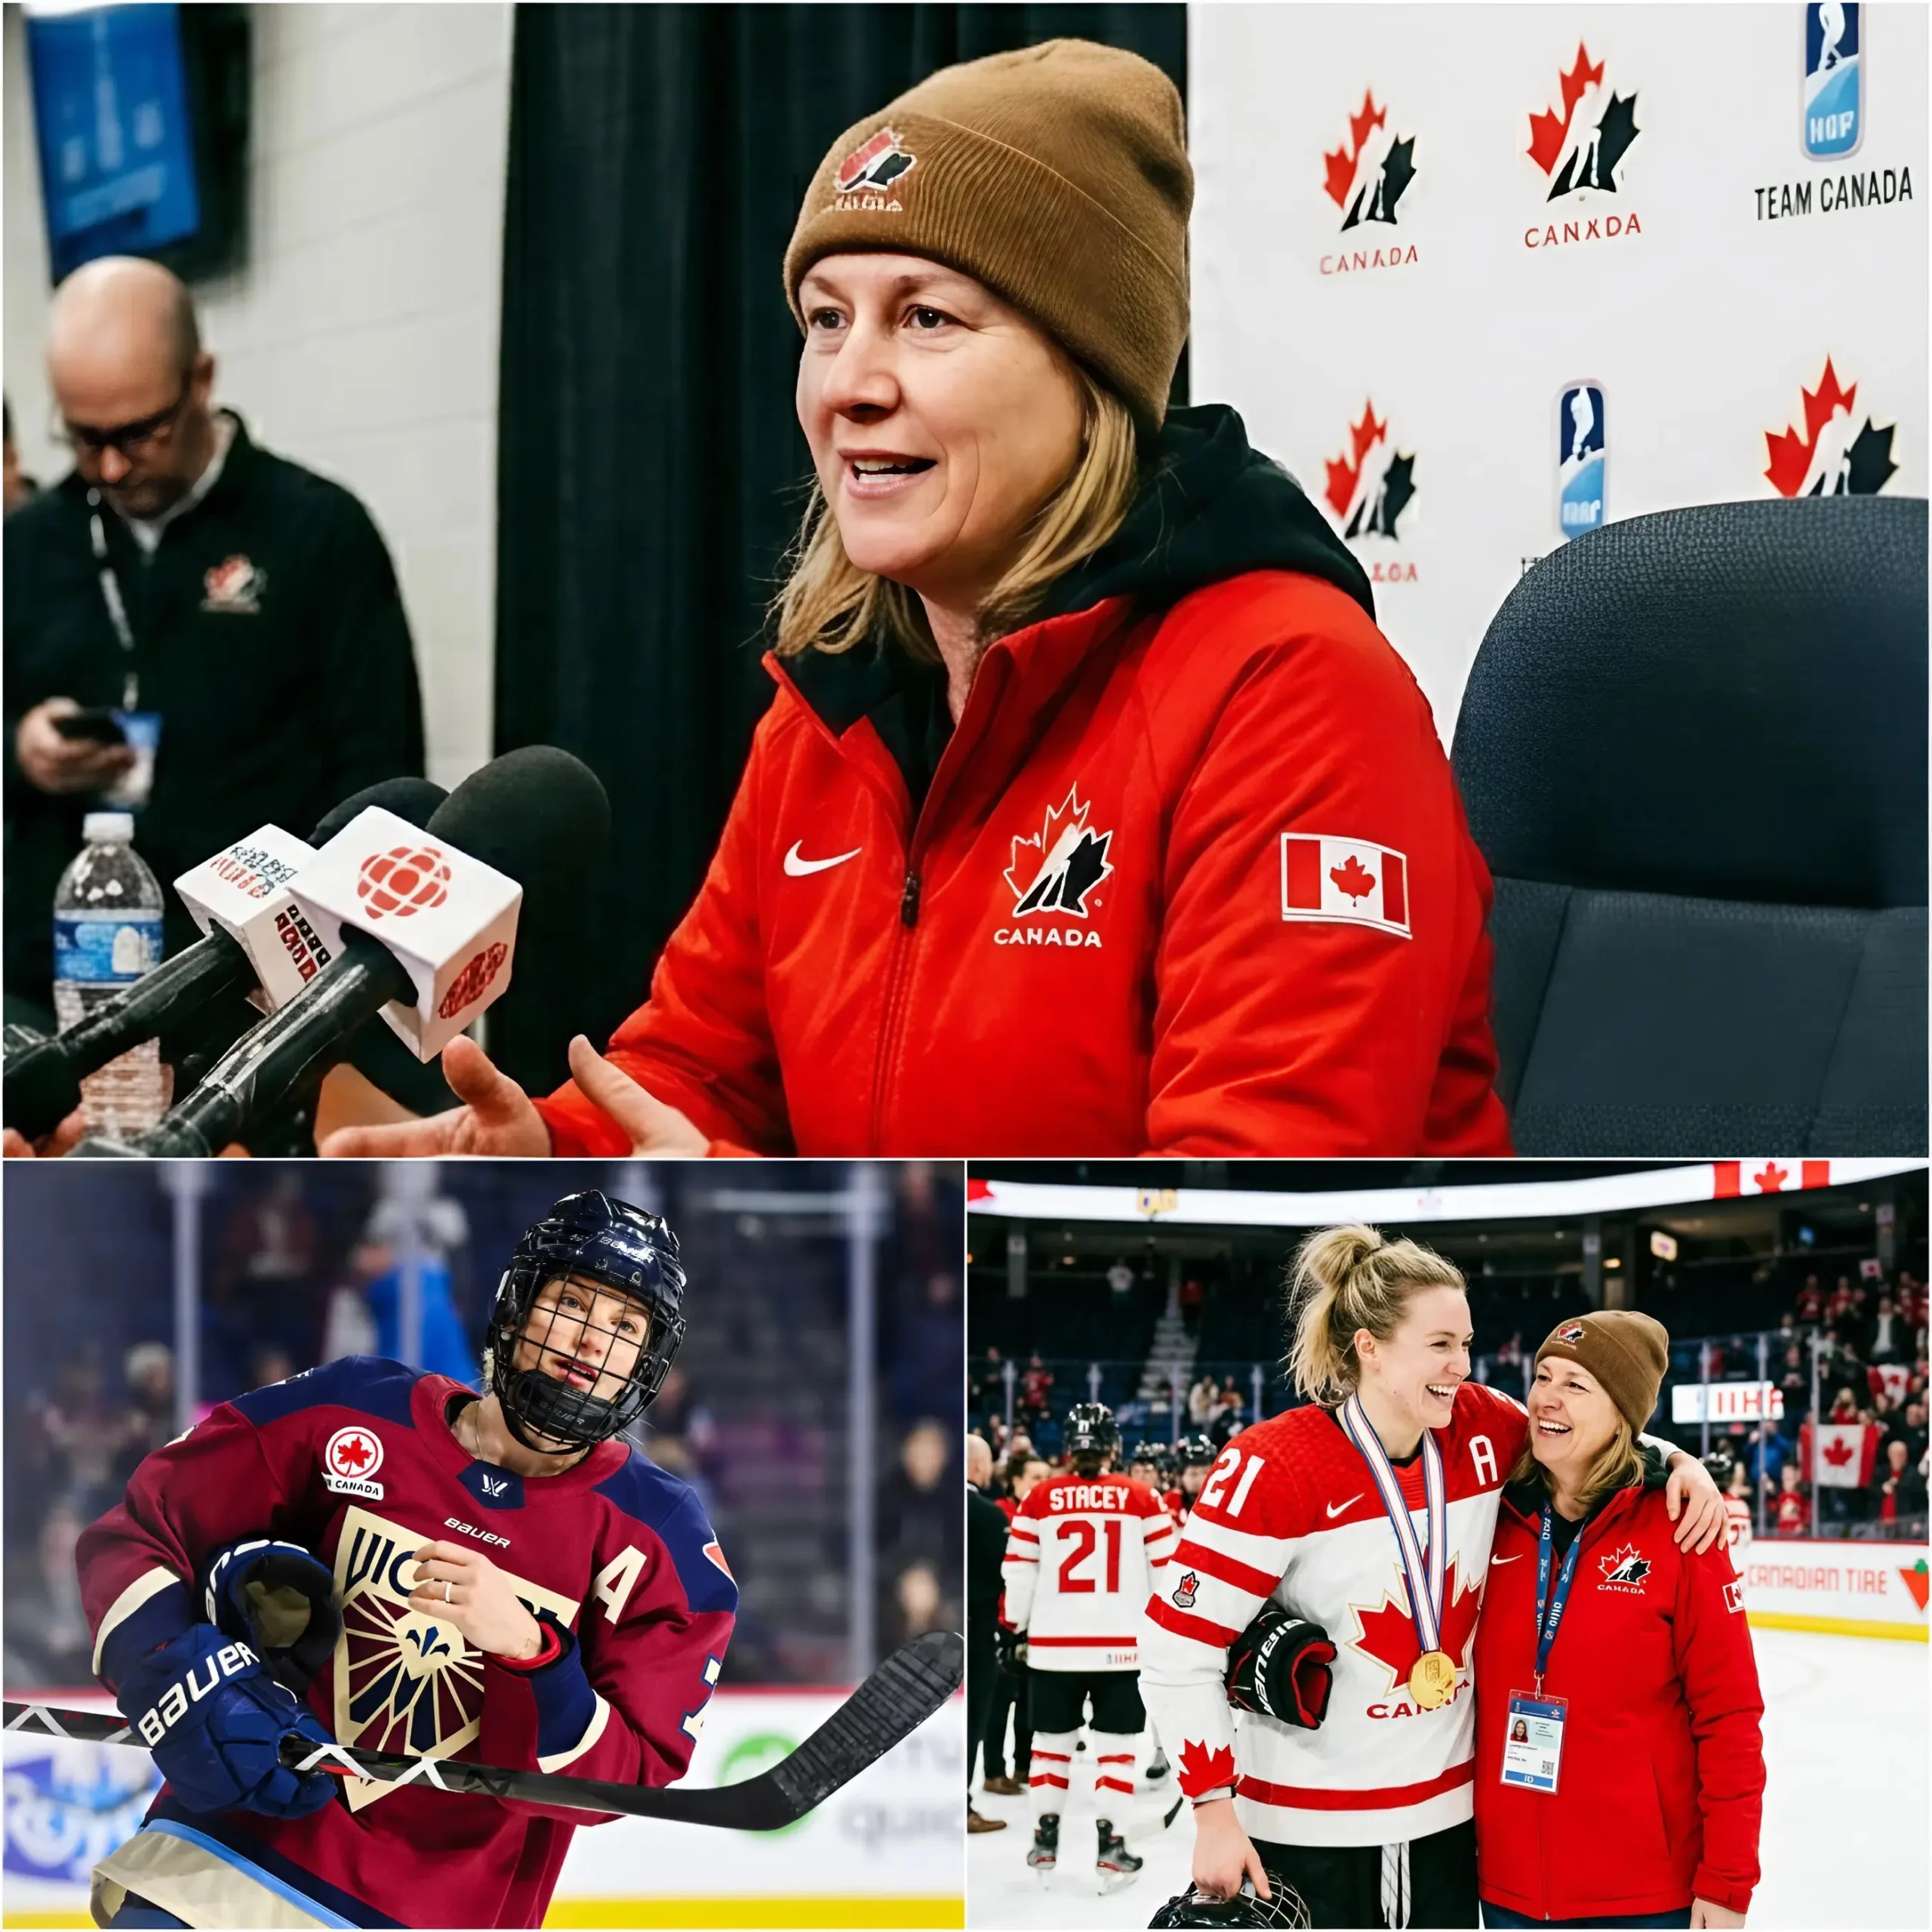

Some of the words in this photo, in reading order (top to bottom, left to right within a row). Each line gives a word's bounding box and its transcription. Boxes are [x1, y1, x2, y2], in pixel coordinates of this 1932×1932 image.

[1755, 180, 1812, 220] TEAM
[1820, 166, 1913, 212] CANADA
[1319, 245, 1418, 275] CANADA
[993, 928, 1103, 948] CANADA
[1469, 1435, 1499, 1486] A
[335, 1480, 379, 1496] CANADA
[1050, 1485, 1130, 1510] STACEY
[1198, 1447, 1266, 1518] 21
[1057, 1520, 1122, 1593] 21
[592, 1544, 648, 1625] A
[1597, 1584, 1646, 1595] CANADA
[1748, 1564, 1840, 1592] CANADIAN
[1845, 1569, 1887, 1595] TIRE
